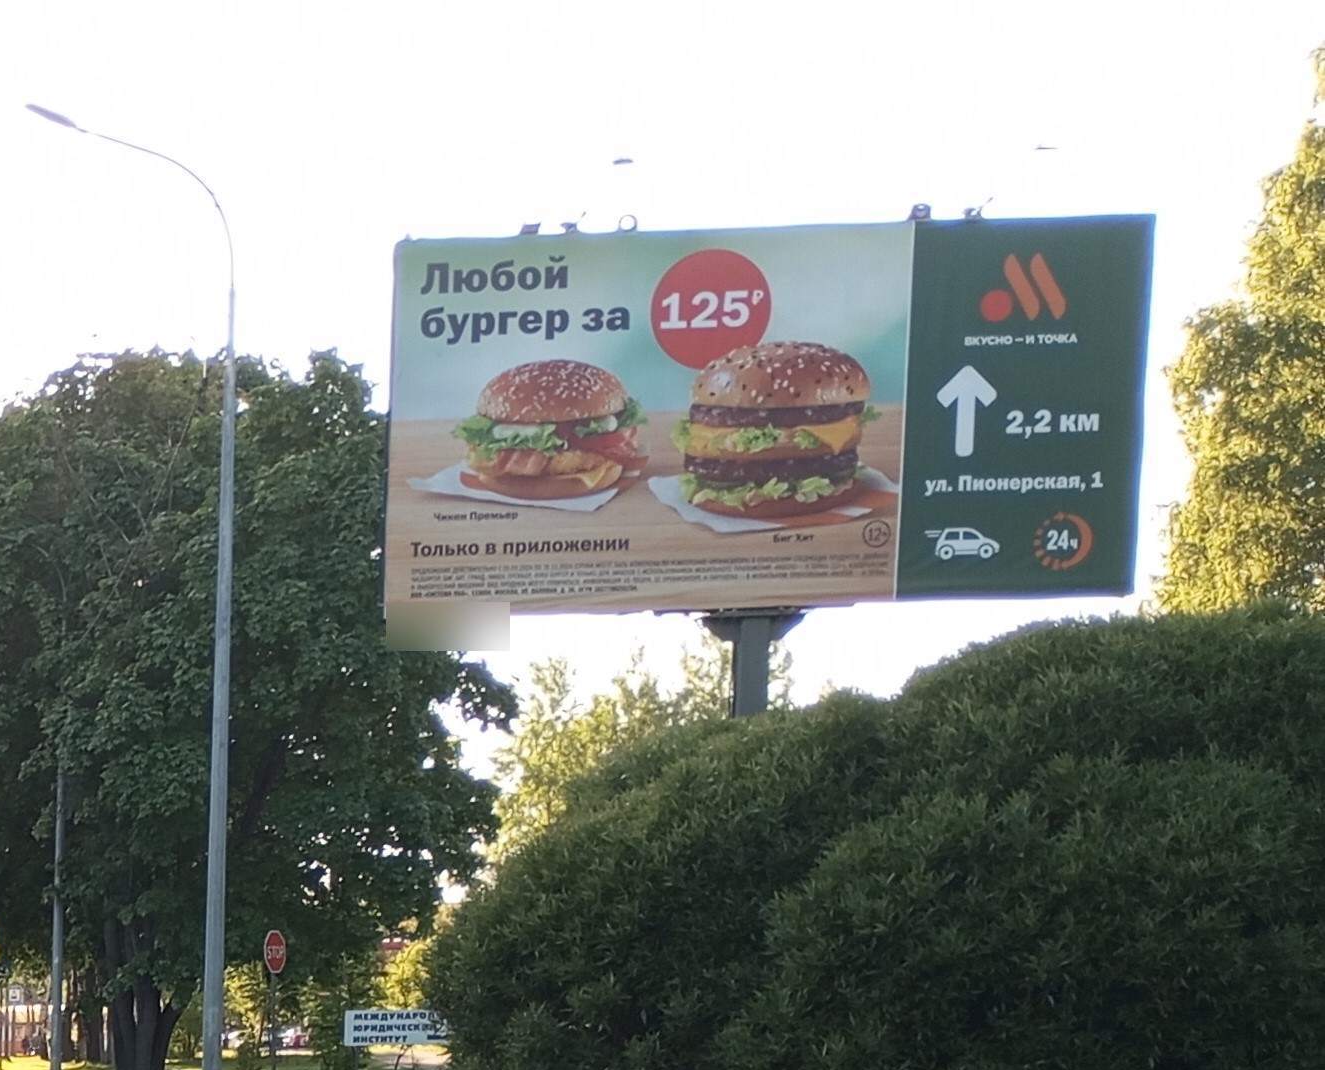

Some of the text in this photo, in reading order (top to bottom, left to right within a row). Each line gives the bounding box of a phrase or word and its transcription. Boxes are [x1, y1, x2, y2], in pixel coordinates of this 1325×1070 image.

[420, 255, 569, 295] Любой
[420, 306, 631, 345] бургер за
[964, 335, 1013, 346] ВКУСНО
[1025, 335, 1034, 344] И
[1037, 333, 1078, 344] ТОЧКА
[1005, 409, 1052, 439] 2,2
[924, 471, 1104, 496] ул. Пионерская, 1
[411, 537, 631, 558] Только в приложении
[268, 945, 285, 959] STOP
[354, 1012, 438, 1021] МЕЖДУНАРОД
[353, 1035, 407, 1043] ИНСТИТУТ
